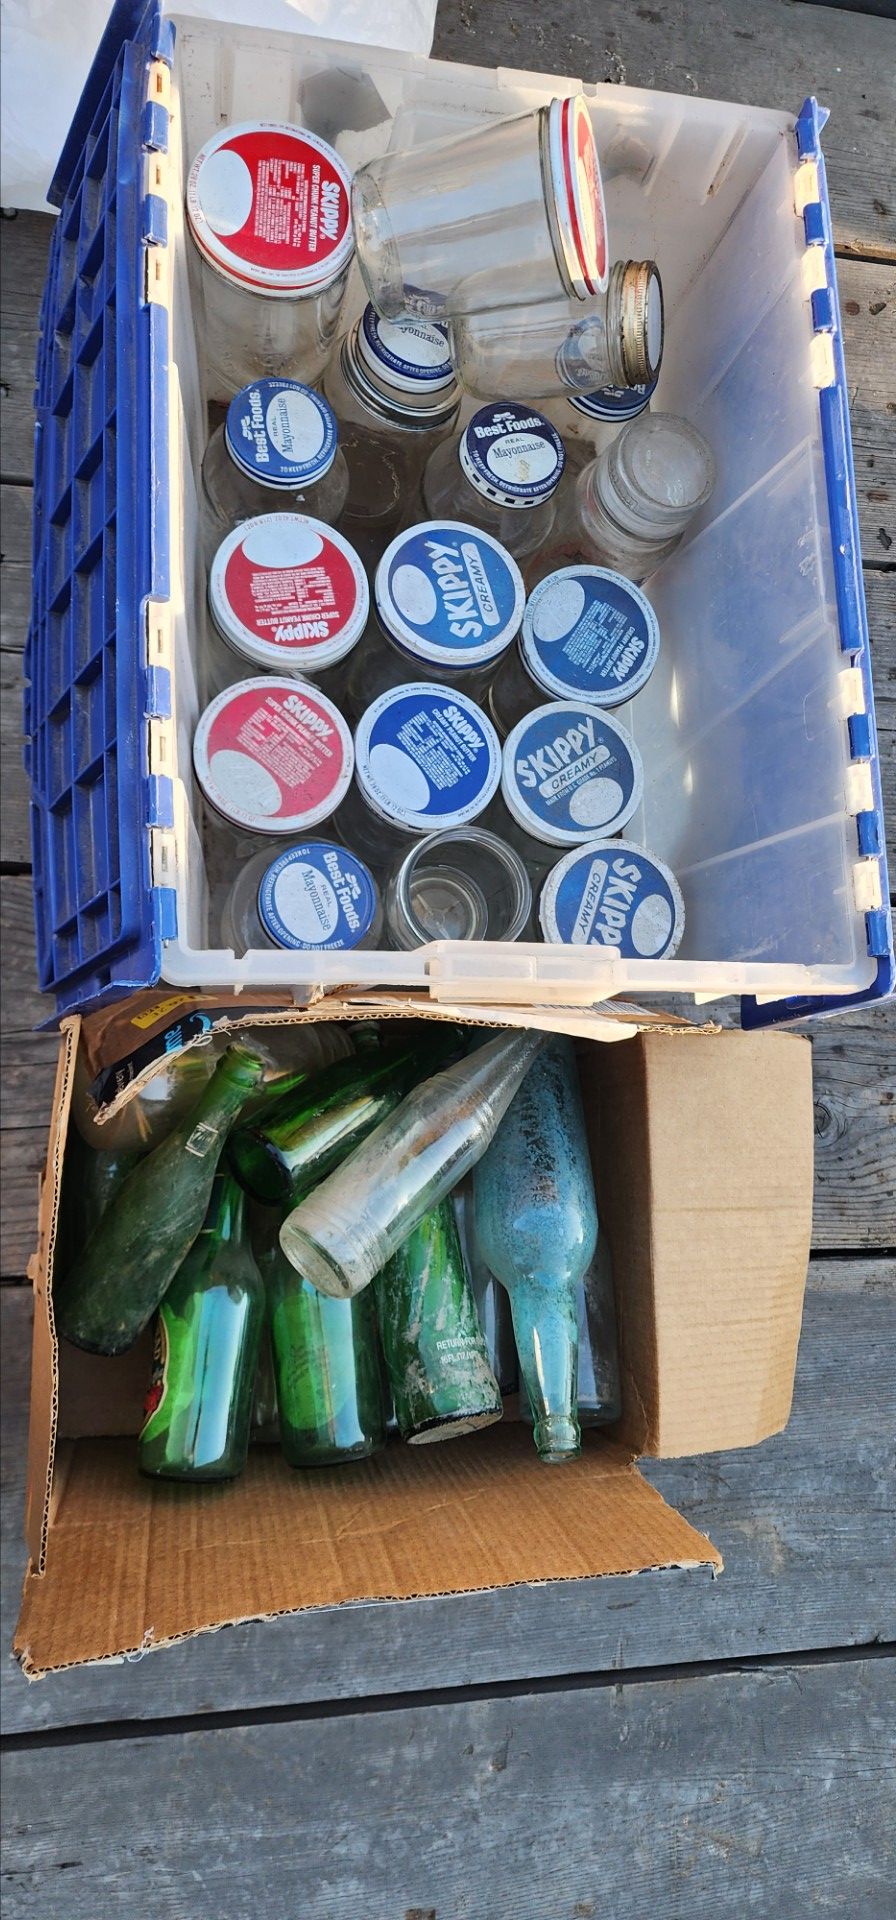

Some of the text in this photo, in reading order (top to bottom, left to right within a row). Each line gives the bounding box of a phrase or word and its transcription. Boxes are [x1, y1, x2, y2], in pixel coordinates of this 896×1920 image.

[312, 165, 320, 184] SUPER
[319, 181, 341, 240] SKIPPY
[309, 229, 317, 252] BUTTER
[397, 325, 444, 347] yonnaise
[249, 391, 269, 462] Best Foods
[278, 398, 295, 453] Mayonnaise
[474, 417, 542, 439] Best Foods
[492, 441, 545, 458] Mayonnaise
[424, 540, 482, 638] SKIPPY
[467, 555, 493, 612] CREAMY
[256, 611, 339, 626] SUPER CHUNK PEANUT BUTTER
[274, 621, 329, 642] SKIPPY
[599, 659, 615, 678] BUTTER
[609, 642, 625, 661] PEANUT
[614, 636, 646, 682] SKIPPY
[265, 696, 283, 712] SUPER
[313, 740, 333, 757] BUTTER
[282, 695, 334, 739] SKIPPY
[431, 708, 477, 762] CREAMY PEANUT BUTTER
[442, 704, 485, 750] SKIPPY
[515, 716, 595, 788] SKIPPY
[549, 752, 598, 790] CREAMY
[265, 874, 276, 912] REFRIGERATE
[301, 869, 331, 931] Mayonnaise
[321, 884, 332, 908] REAL
[323, 851, 360, 930] Best Foods
[580, 874, 601, 934] CREAMY
[590, 858, 640, 947] SKIPP
[268, 912, 280, 930] AFTER
[436, 1337, 464, 1350] RETURN
[464, 1336, 476, 1345] FOR
